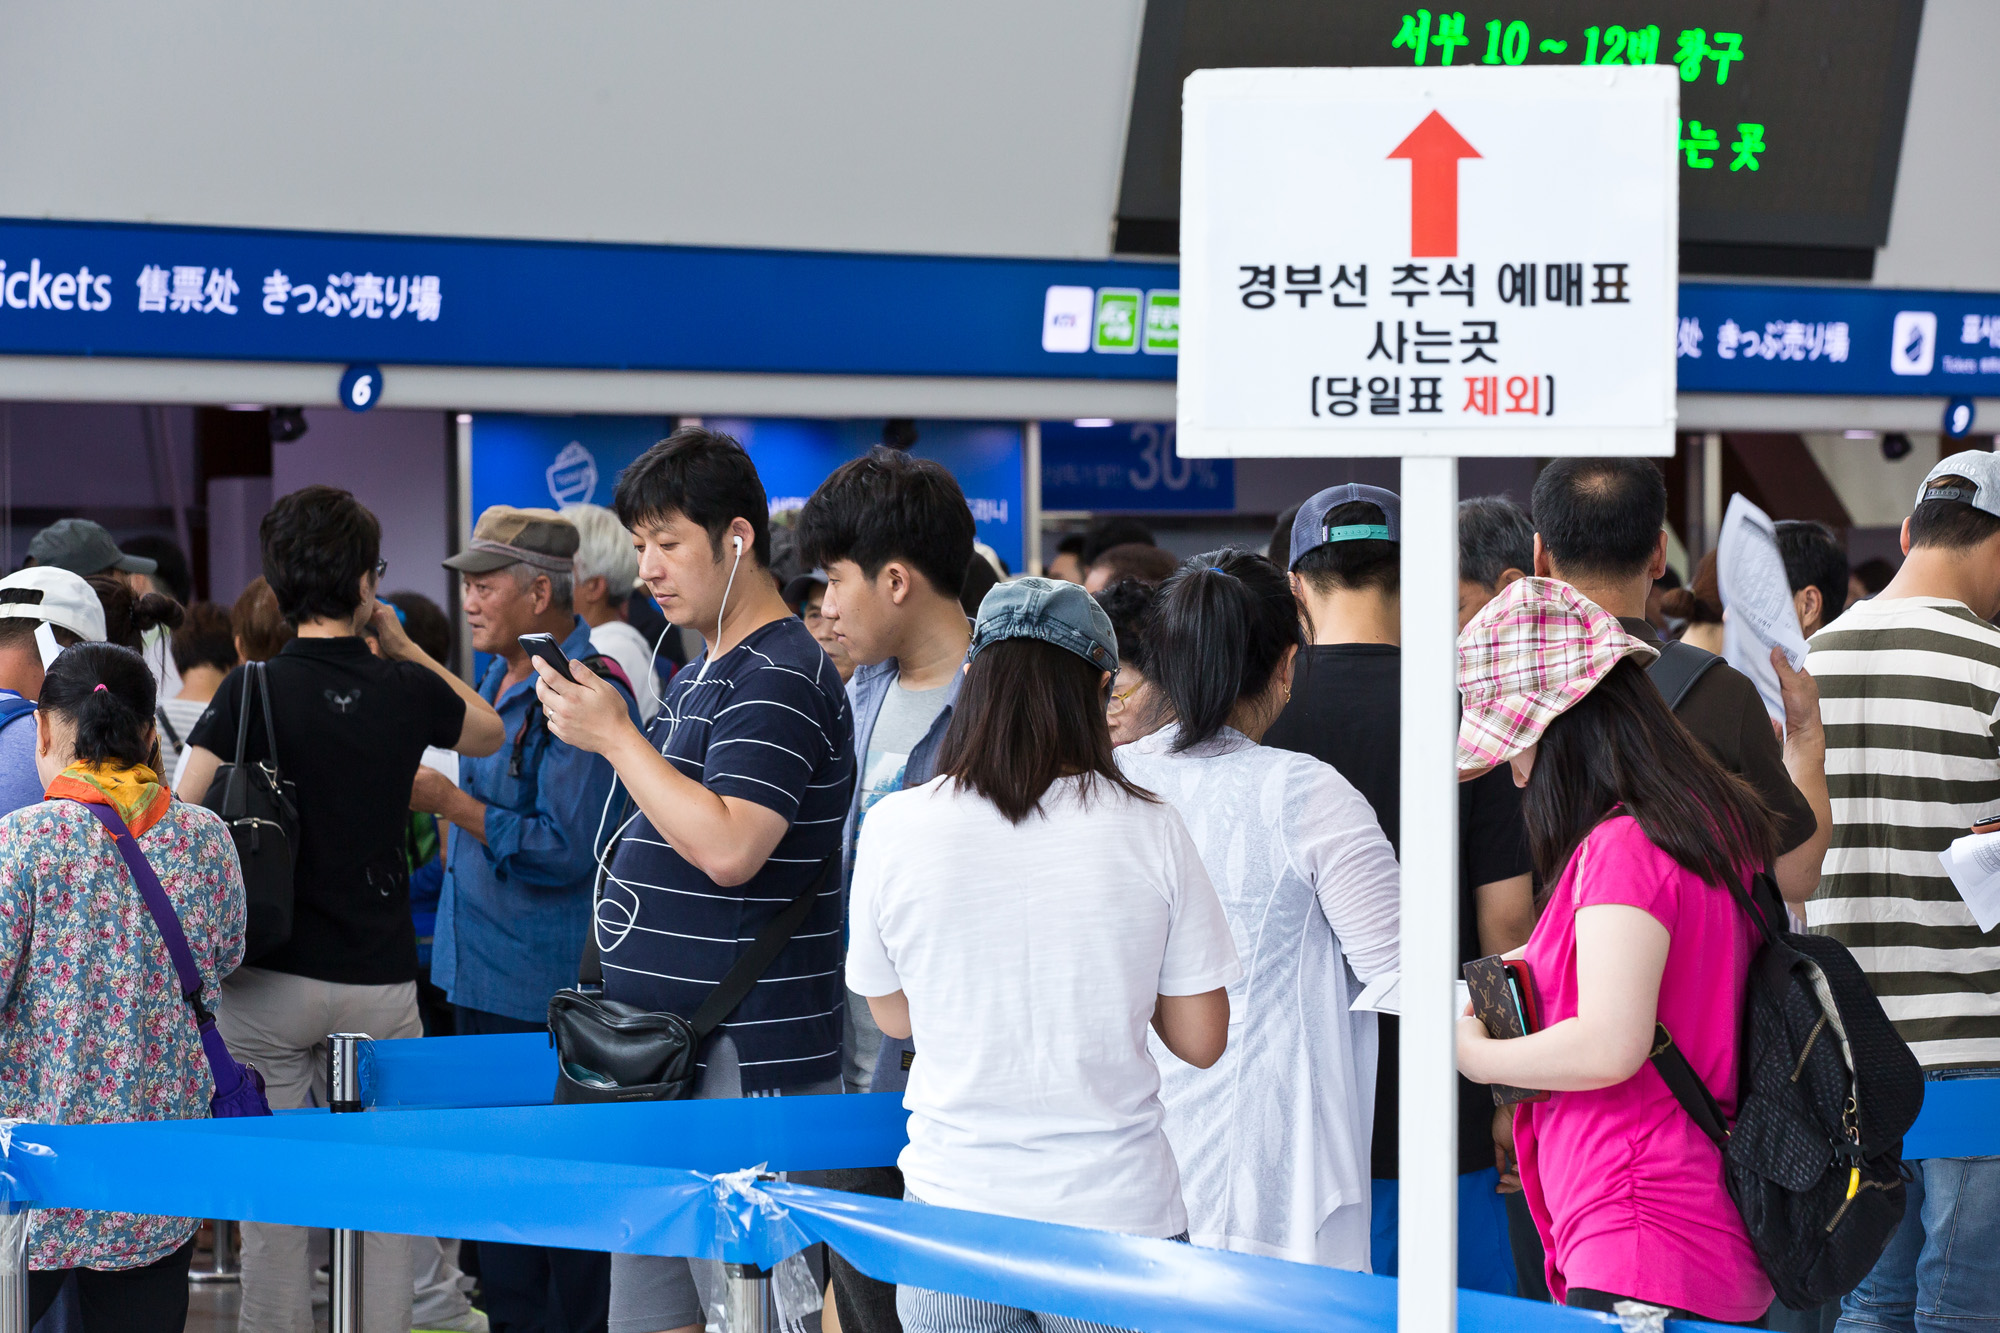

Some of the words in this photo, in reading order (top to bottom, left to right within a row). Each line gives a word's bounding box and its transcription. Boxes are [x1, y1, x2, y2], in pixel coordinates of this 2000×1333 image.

[1391, 8, 1470, 66] 서부
[1481, 19, 1530, 66] 10
[1673, 27, 1745, 86] 창구
[1677, 118, 1720, 169] 는
[1729, 123, 1766, 171] 곳
[136, 264, 240, 315] 售票处
[261, 269, 443, 322] きっぷ売り場
[1238, 263, 1368, 309] 경부선
[1390, 263, 1475, 307] 추석
[1497, 263, 1631, 307] 예매표
[1366, 320, 1499, 364] 사는곳
[352, 375, 372, 406] 6
[1952, 404, 1970, 434] 9
